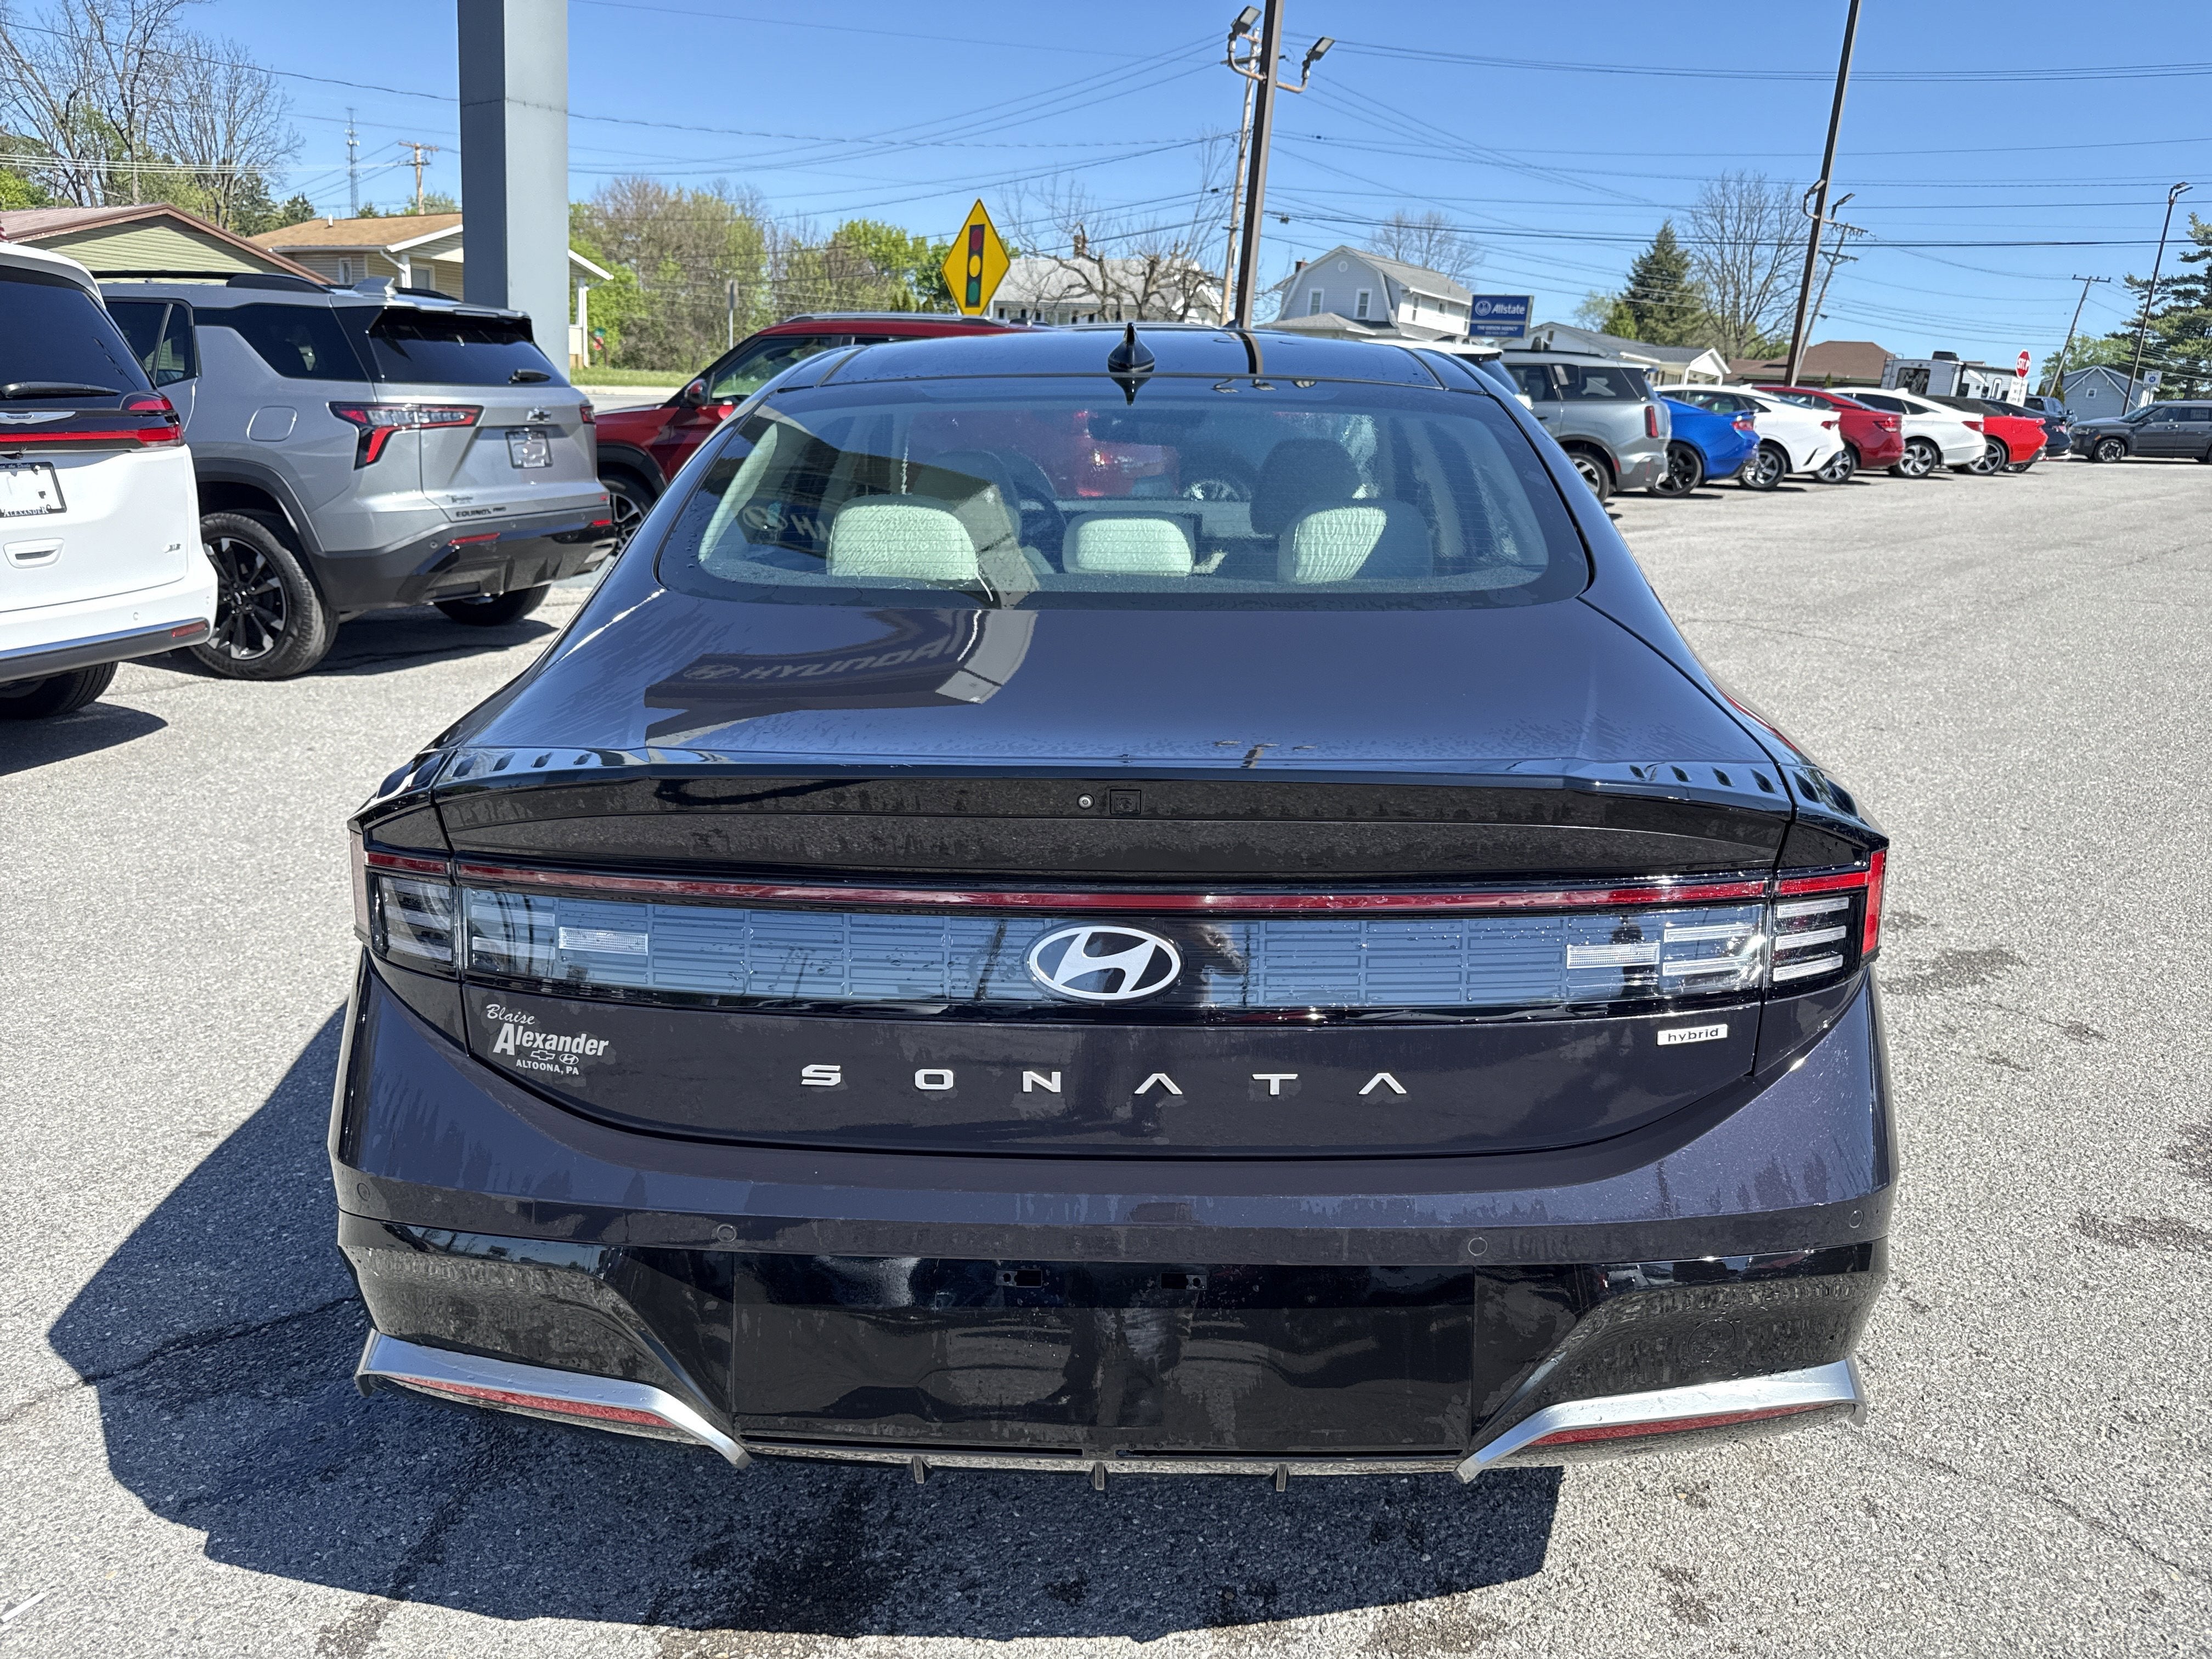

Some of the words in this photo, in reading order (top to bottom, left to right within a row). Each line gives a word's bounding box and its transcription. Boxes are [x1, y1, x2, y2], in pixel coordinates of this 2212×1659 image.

[1491, 303, 1525, 314] Allstate
[2017, 358, 2030, 371] STOP
[4, 506, 49, 517] ALEXANDER
[486, 1003, 535, 1025] Blaise
[493, 1023, 609, 1056] Alexander
[1668, 1028, 1719, 1042] hybrid
[516, 1059, 564, 1075] ALTOONA,
[566, 1066, 579, 1075] PA
[800, 1064, 1407, 1096] SONATA
